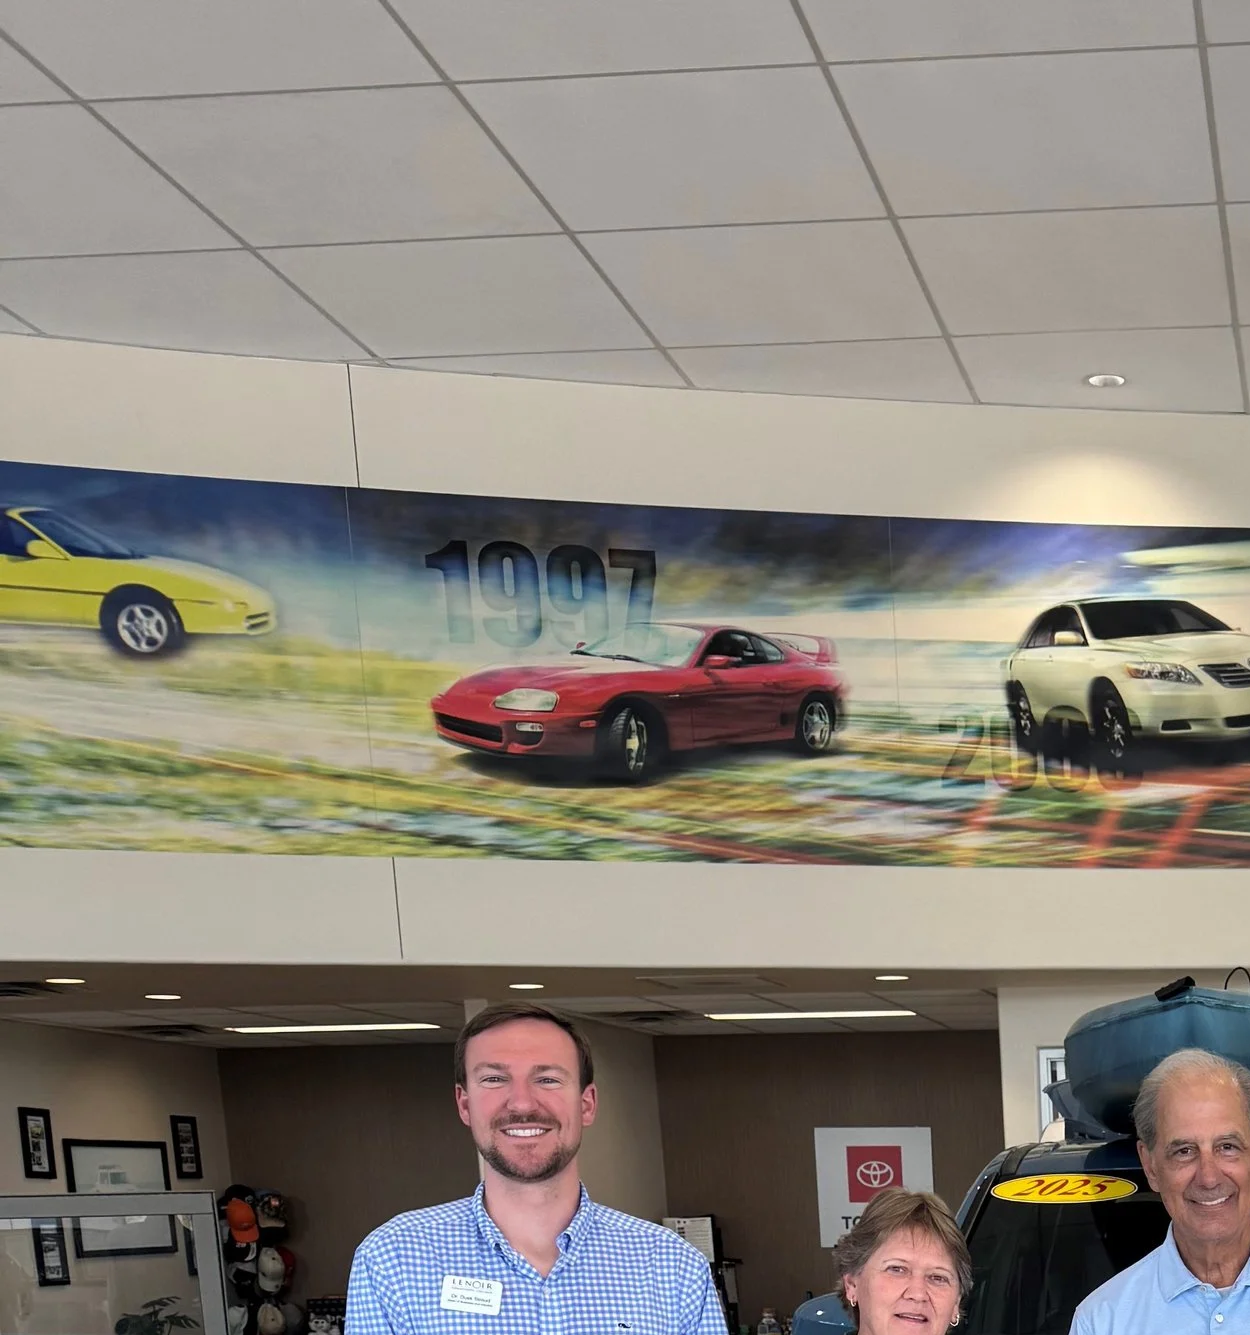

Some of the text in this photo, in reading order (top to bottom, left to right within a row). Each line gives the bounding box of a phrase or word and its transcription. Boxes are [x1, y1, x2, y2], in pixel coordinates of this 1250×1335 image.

[425, 540, 657, 648] 1997
[1022, 1176, 1117, 1196] 2025
[452, 1278, 493, 1290] LENOIR
